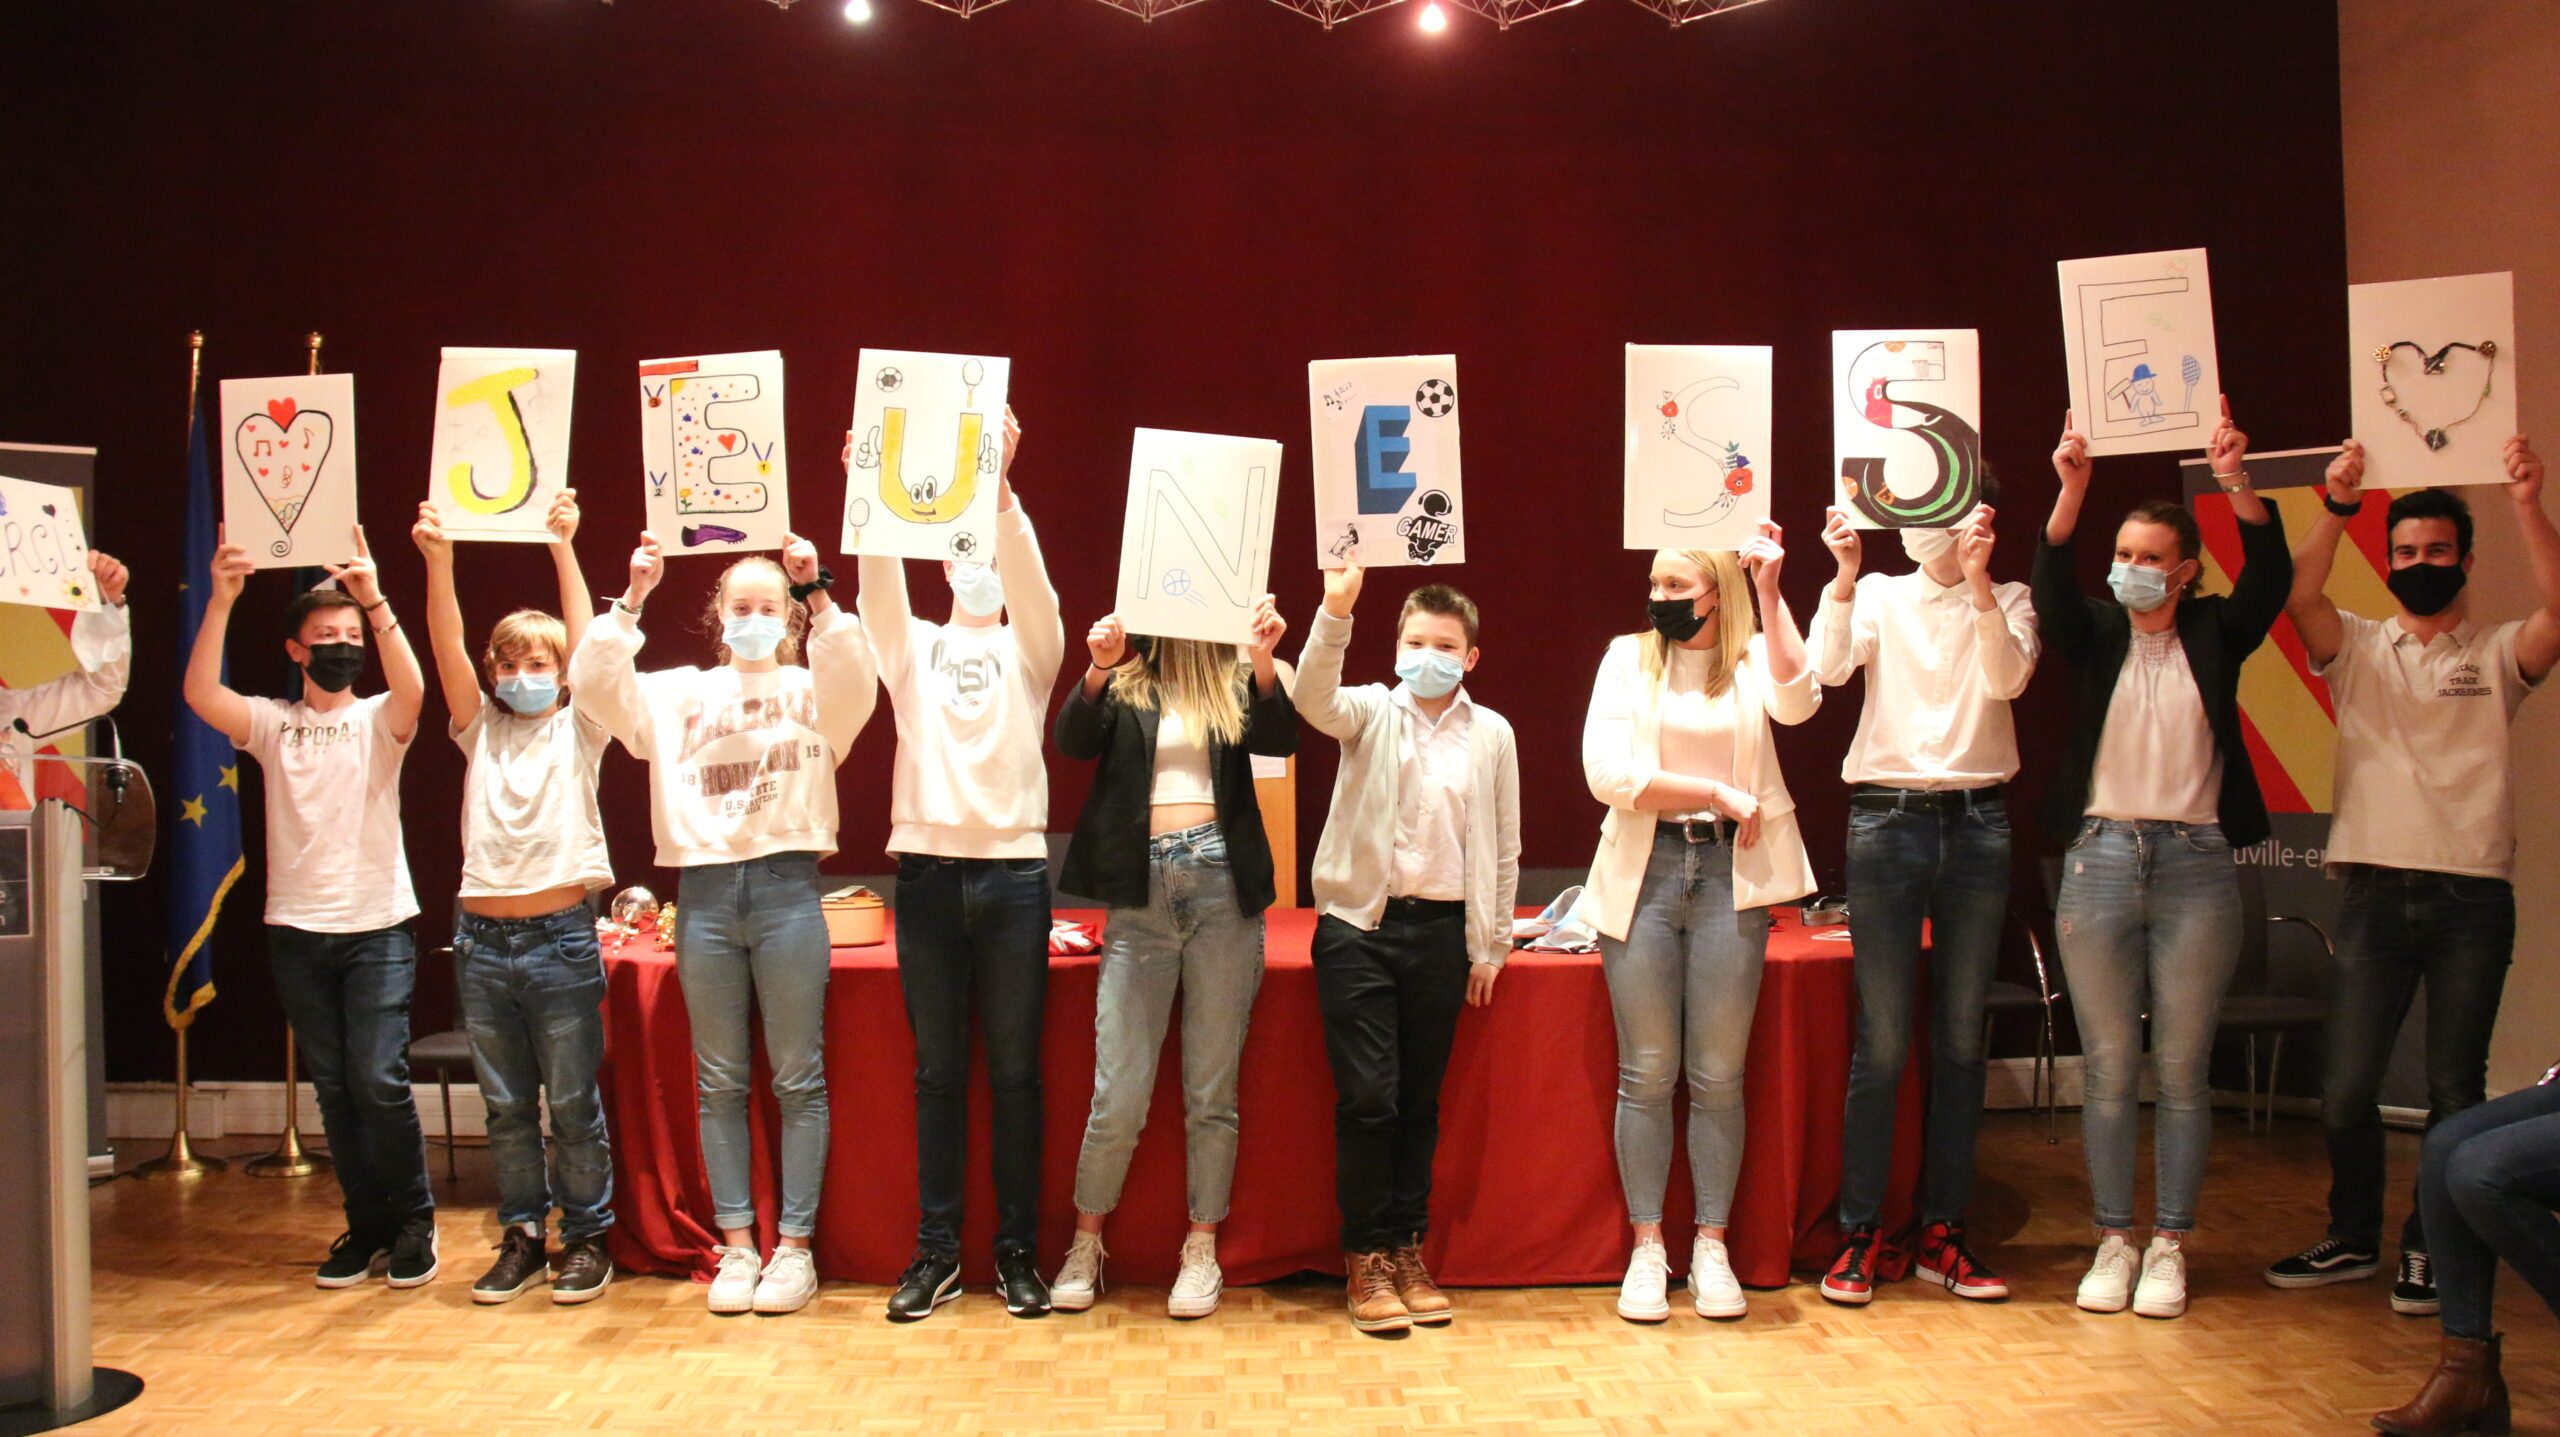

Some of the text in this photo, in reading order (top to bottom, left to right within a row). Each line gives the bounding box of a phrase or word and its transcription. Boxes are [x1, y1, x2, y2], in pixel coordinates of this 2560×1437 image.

[2078, 277, 2199, 440] E
[447, 368, 539, 515] J
[670, 374, 768, 514] E
[879, 408, 982, 524] U
[1355, 405, 1417, 514] E
[1662, 376, 1745, 528] S
[1841, 341, 1978, 528] S
[0, 521, 78, 577] RCI
[1137, 466, 1265, 608] N
[1397, 517, 1457, 543] GAMER
[280, 721, 358, 748] KAPORA
[806, 744, 821, 758] 19
